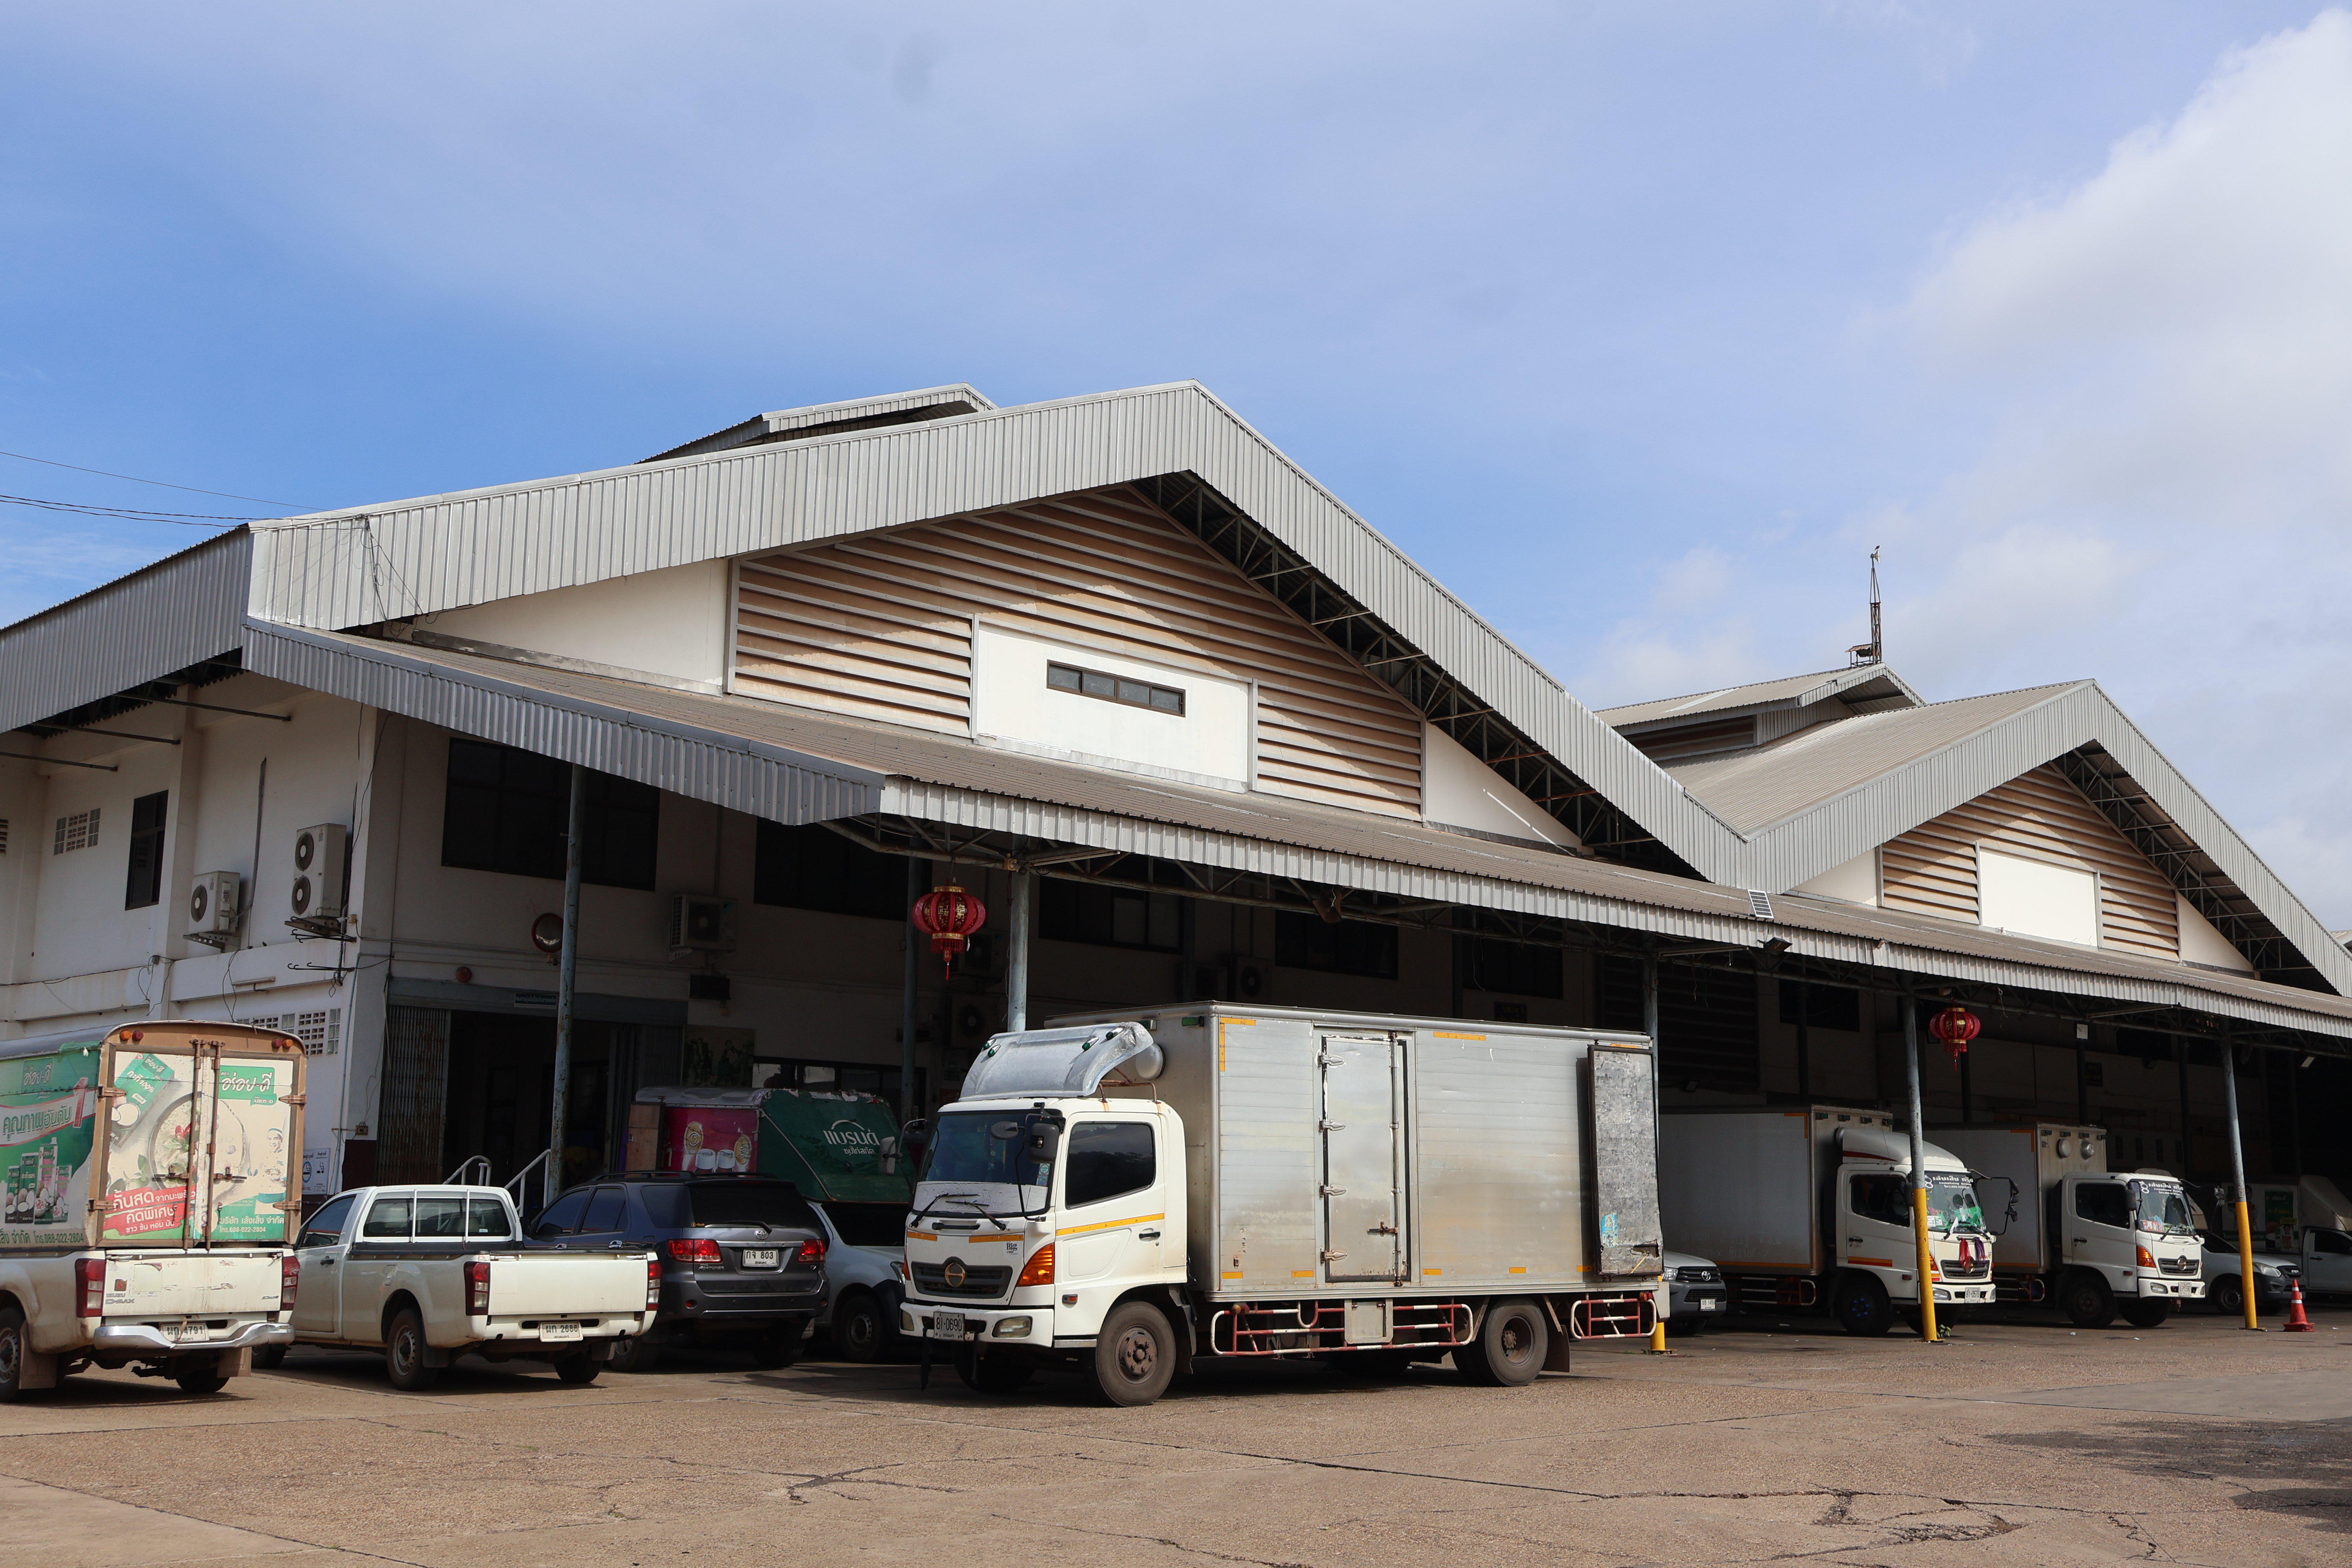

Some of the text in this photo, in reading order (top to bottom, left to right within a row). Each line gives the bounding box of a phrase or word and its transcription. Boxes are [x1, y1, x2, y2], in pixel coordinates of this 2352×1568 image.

[221, 1072, 273, 1092] อร่อย-ดี
[3, 1077, 89, 1141] คุณภาพอันดับ 1
[155, 1190, 196, 1202] จากมะพร้ว
[241, 1215, 264, 1224] เล้งเส็ง
[267, 1216, 285, 1224] จำกัด
[1006, 1243, 1018, 1251] Big
[746, 1251, 756, 1259] กจ
[560, 1324, 578, 1333] 2686
[936, 1317, 962, 1331] 81-0690
[184, 1325, 202, 1335] 4791
